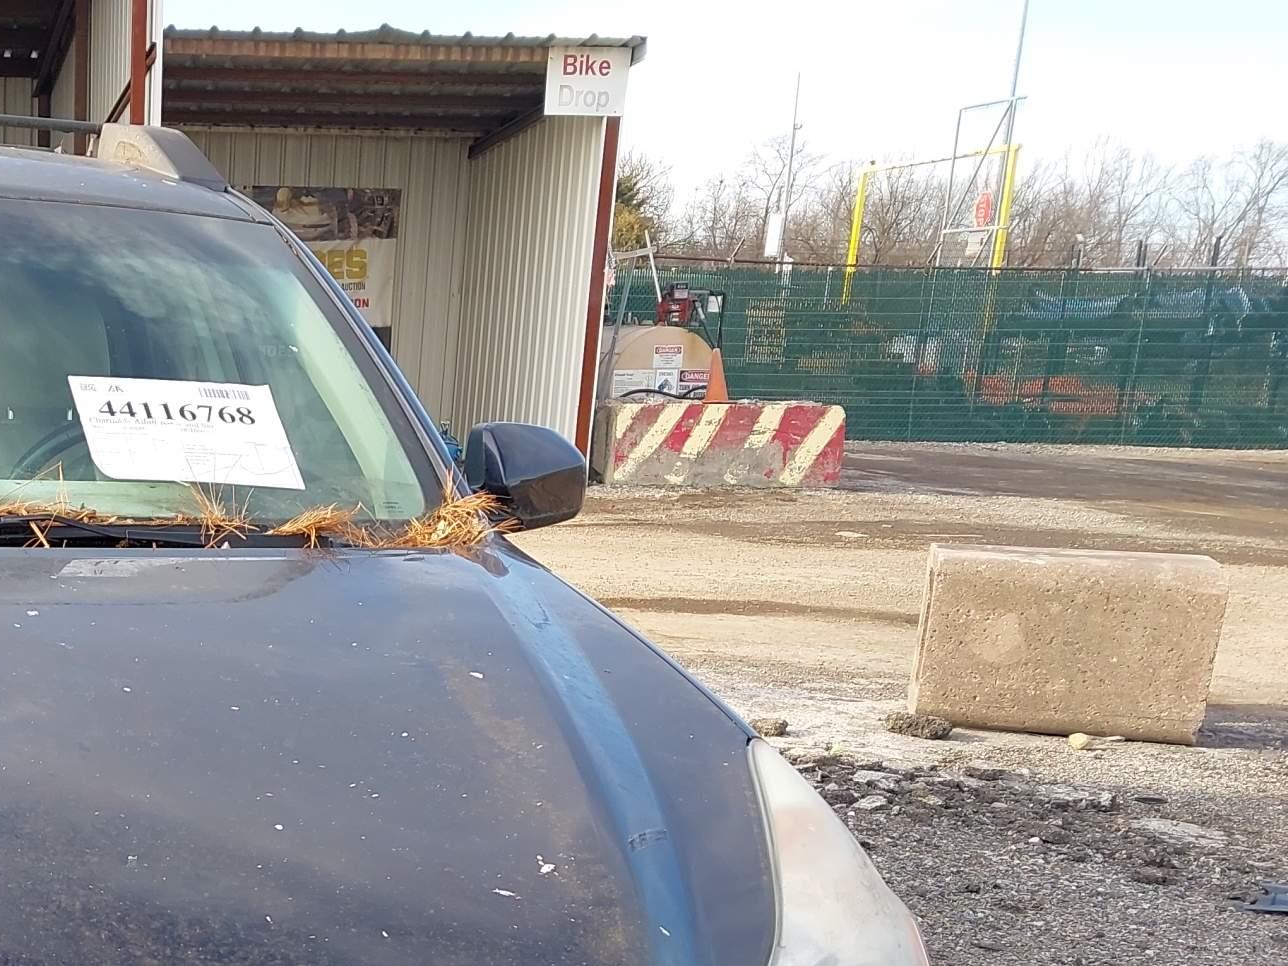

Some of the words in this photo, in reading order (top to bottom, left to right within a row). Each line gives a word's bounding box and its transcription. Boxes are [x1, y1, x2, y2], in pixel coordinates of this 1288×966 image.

[563, 54, 611, 76] Bike
[559, 84, 610, 112] Drop
[684, 372, 710, 381] DANGE
[98, 400, 256, 426] 44116768
